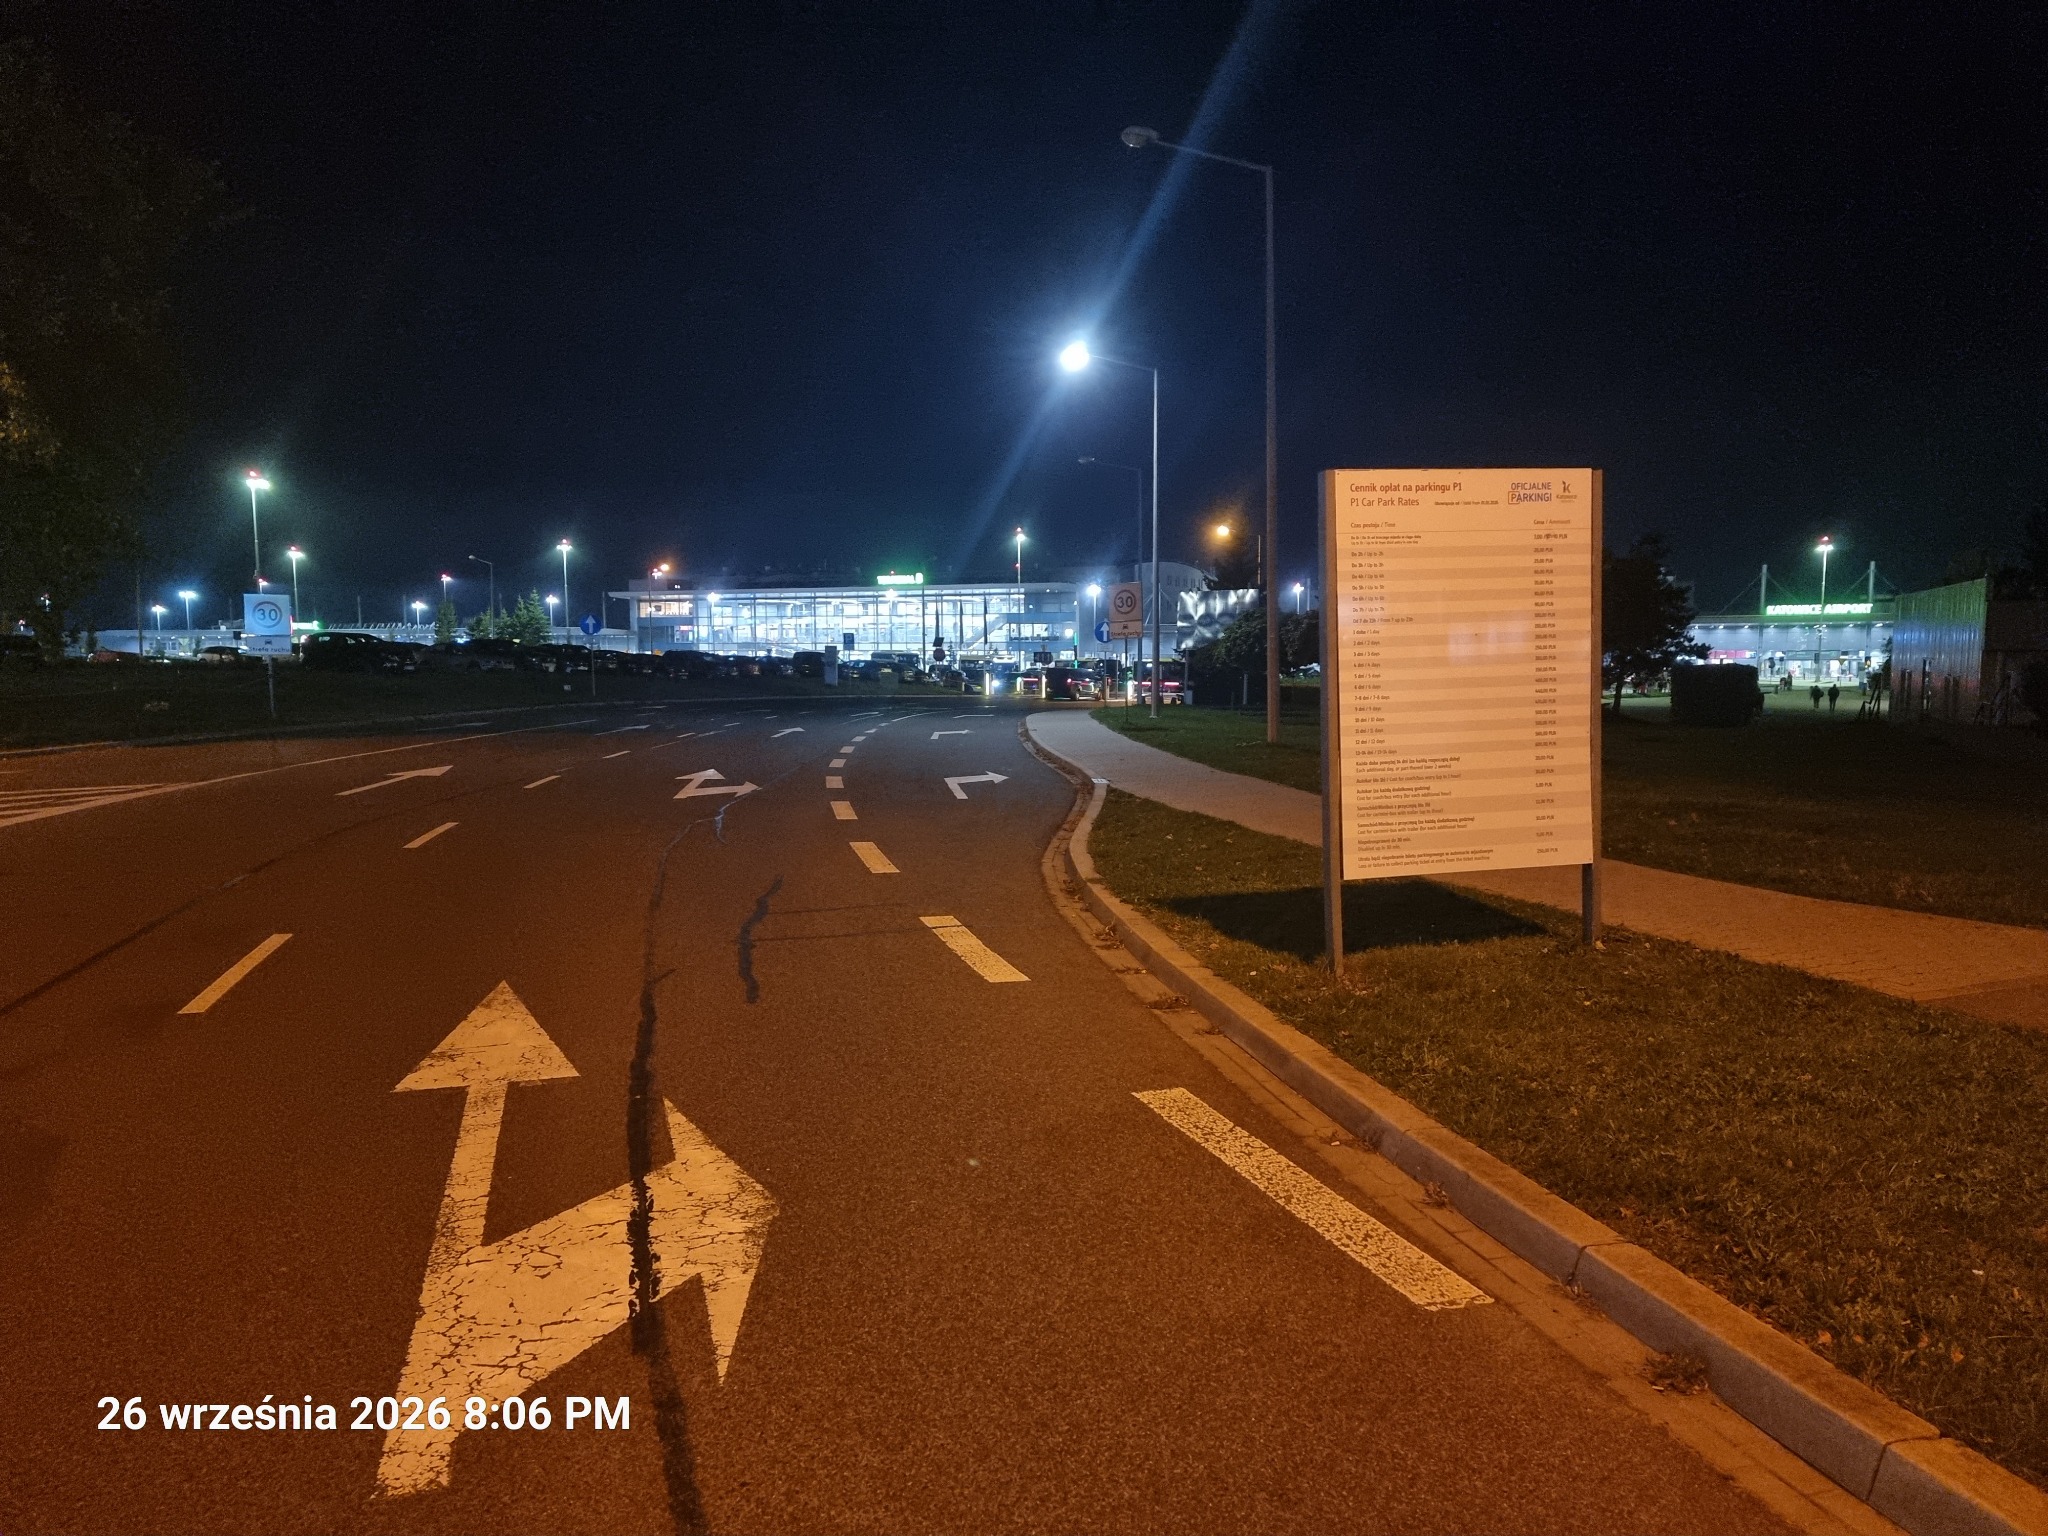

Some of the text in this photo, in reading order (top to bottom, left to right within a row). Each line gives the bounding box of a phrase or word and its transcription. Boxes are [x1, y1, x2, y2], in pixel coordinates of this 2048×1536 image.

[1350, 484, 1377, 492] Cennik
[1380, 483, 1401, 493] opłat
[1415, 482, 1451, 493] parkingu
[1453, 483, 1462, 491] P1
[1511, 482, 1551, 490] OFICJALNE
[1350, 498, 1420, 506] P1 Car Park Rates
[1511, 493, 1552, 502] PARKINGI
[1117, 596, 1133, 608] 30
[257, 609, 277, 621] 30
